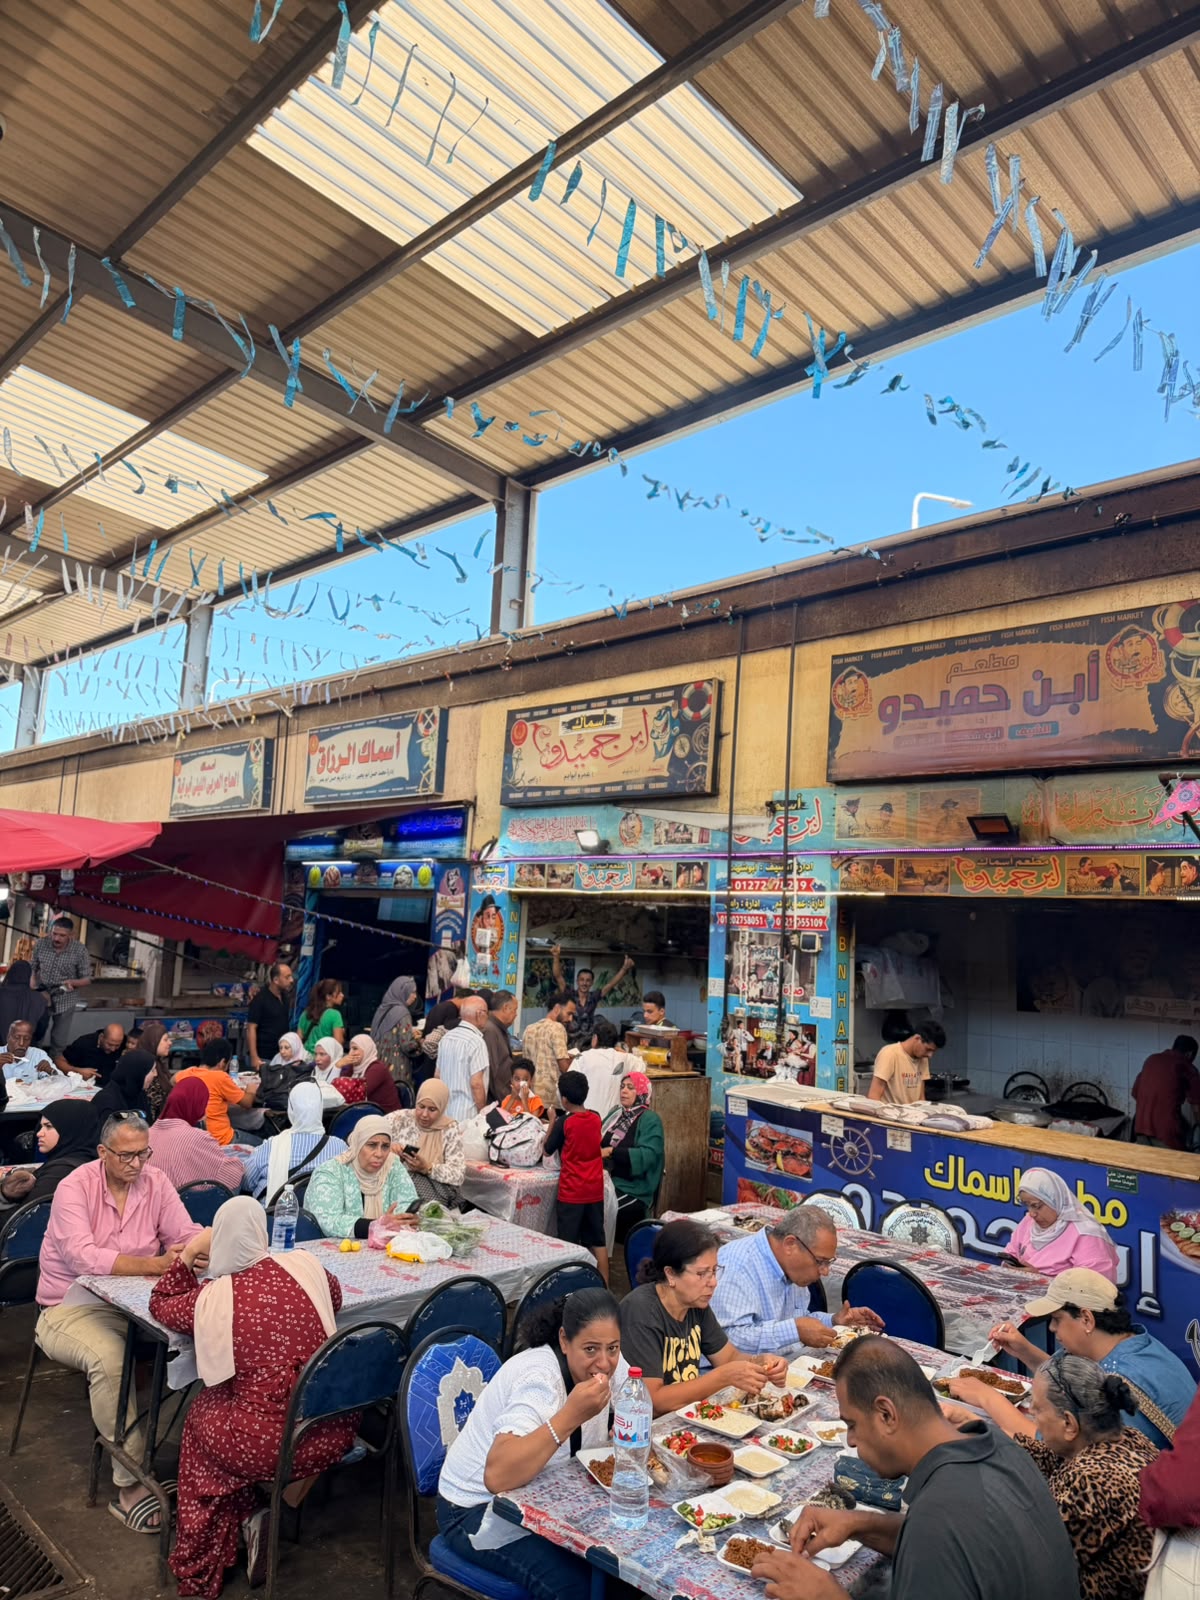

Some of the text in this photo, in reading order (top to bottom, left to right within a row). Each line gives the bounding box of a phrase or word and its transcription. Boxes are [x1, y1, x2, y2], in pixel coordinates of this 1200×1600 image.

[1100, 611, 1145, 624] FISH MARKET
[1049, 619, 1090, 631] FISH MARKET
[968, 634, 992, 644] MARKET
[1001, 628, 1039, 639] FISH MARKET
[883, 648, 904, 658] MARKET
[911, 642, 946, 653] FISH MARKET
[844, 655, 864, 663] MARKET
[947, 654, 1019, 683] مطعم
[878, 683, 1011, 736] حميدو
[572, 709, 607, 730] أسماك
[530, 708, 649, 770] ابن حميدو
[317, 731, 400, 774] أسماك الرزاق
[977, 855, 1049, 867] مطعم اسماك
[953, 855, 1061, 893] ابن حميدو
